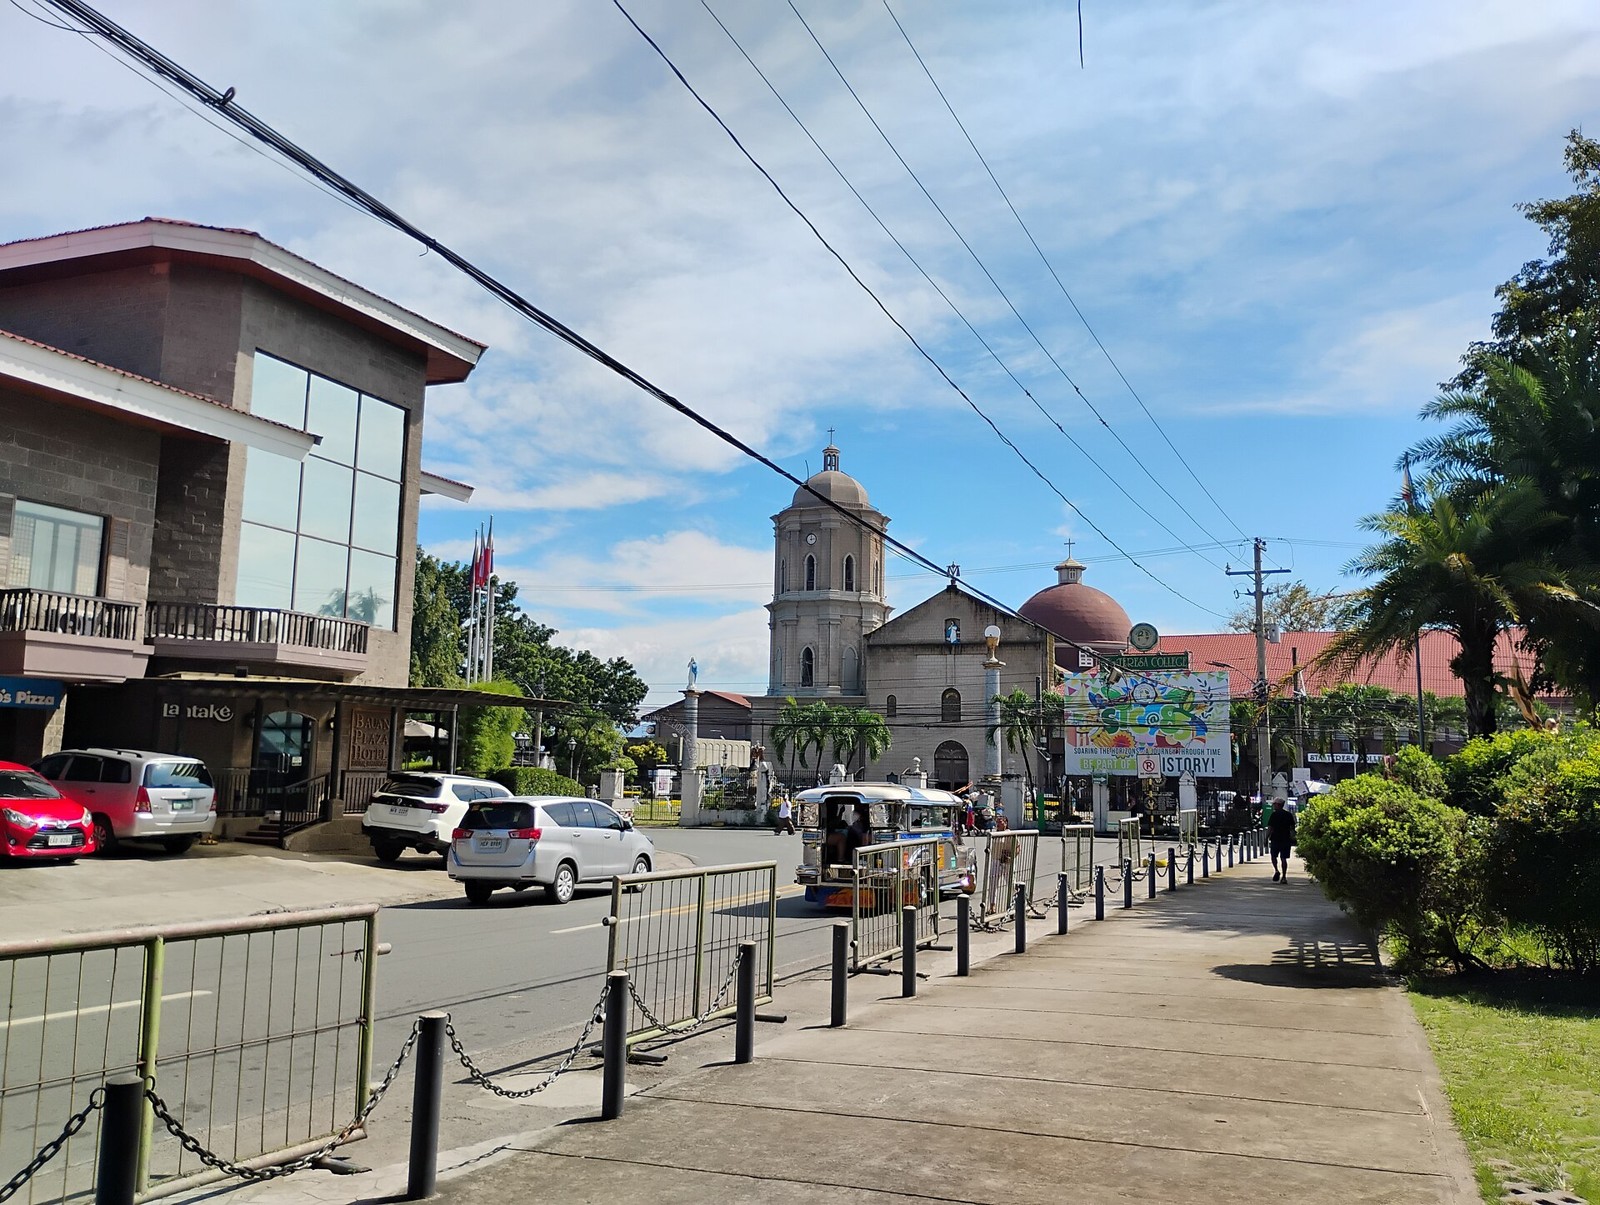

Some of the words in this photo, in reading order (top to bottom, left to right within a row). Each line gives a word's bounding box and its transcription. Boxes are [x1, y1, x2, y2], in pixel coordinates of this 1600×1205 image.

[1151, 656, 1187, 667] COLLEGE
[15, 690, 55, 706] Pizza
[355, 713, 391, 730] BAUAN
[354, 729, 389, 745] PLAZA
[352, 744, 388, 760] HOTEL
[1073, 747, 1098, 755] SOARING
[1099, 747, 1110, 755] THE
[1111, 747, 1139, 755] HORIZONS
[1178, 748, 1205, 756] THROUGH
[1206, 748, 1222, 756] TIME
[1083, 759, 1094, 769] BE
[1096, 759, 1117, 769] PART
[1120, 759, 1131, 769] OF
[1162, 757, 1215, 773] ISTORY!
